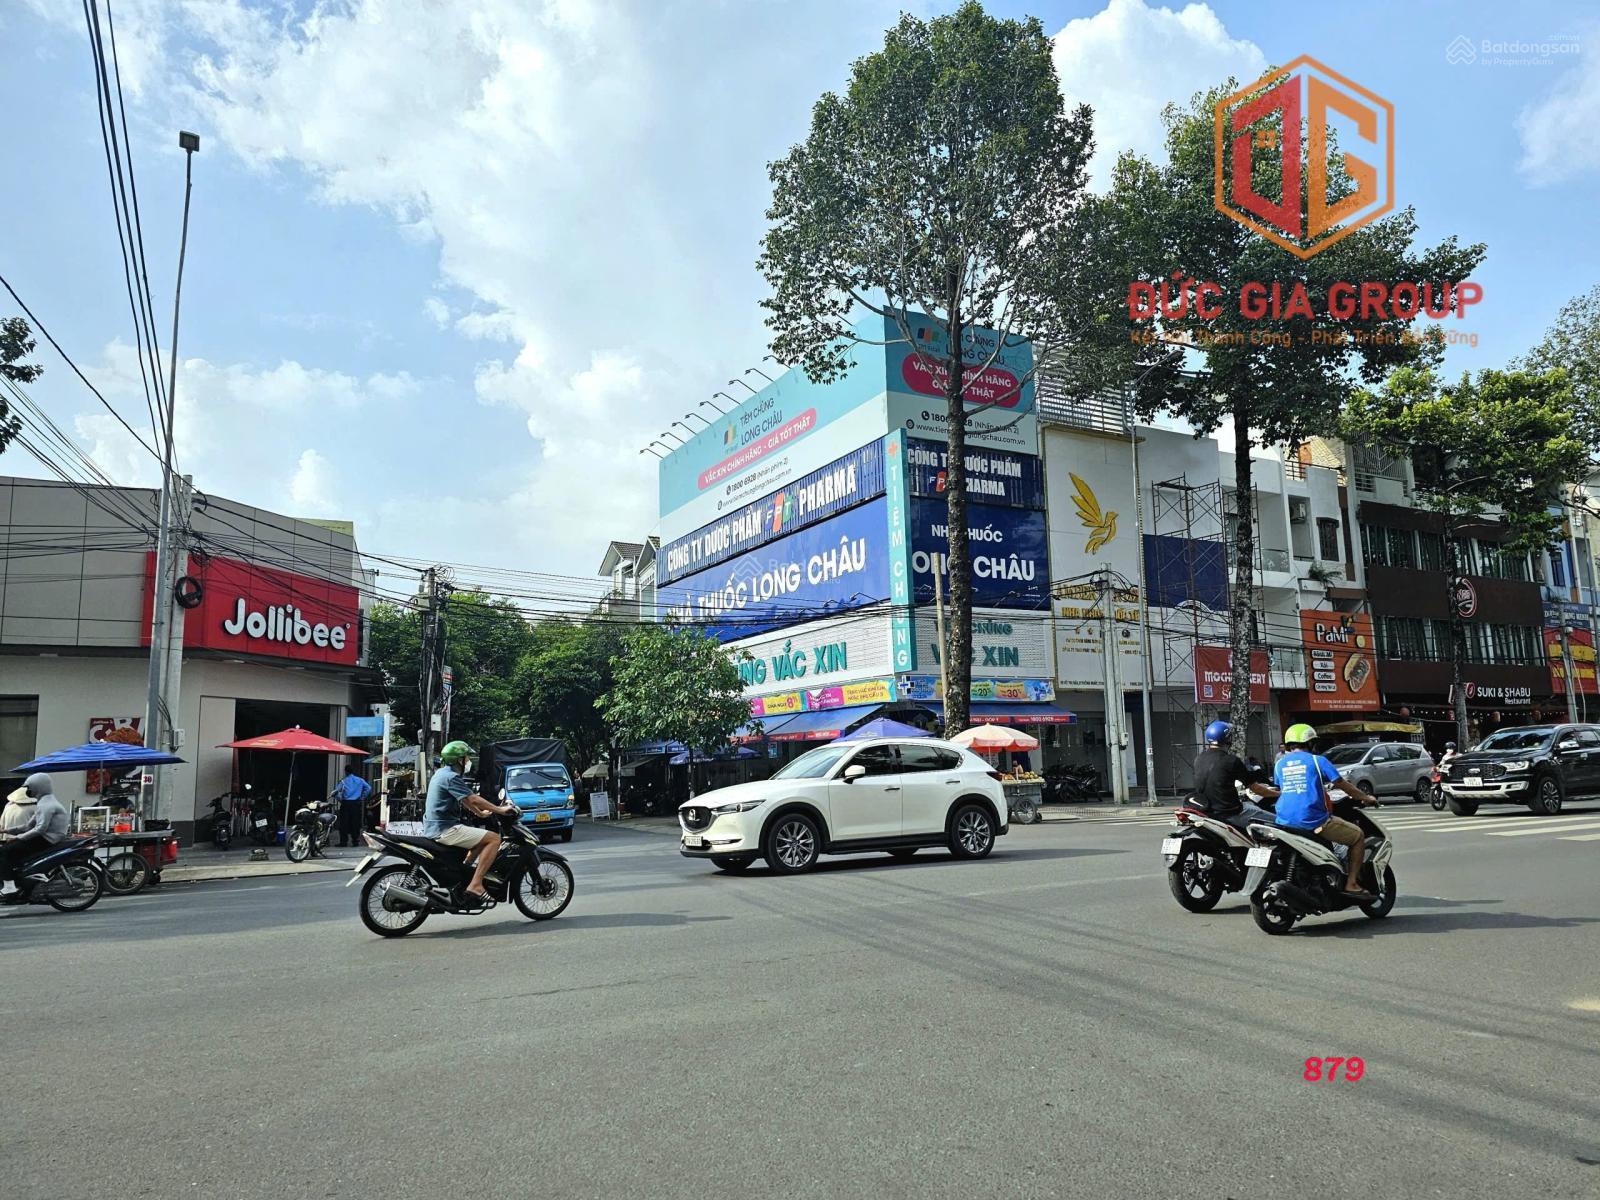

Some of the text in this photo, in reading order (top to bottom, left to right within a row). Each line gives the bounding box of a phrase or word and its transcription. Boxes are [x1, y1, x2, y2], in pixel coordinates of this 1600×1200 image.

[971, 387, 995, 399] THẬT
[985, 374, 1011, 387] HÃNG
[741, 410, 783, 446] LONG CHÂU
[907, 446, 938, 467] CÔNG
[964, 454, 989, 476] ƯỢC
[991, 457, 1021, 478] PHẨM
[966, 477, 1006, 496] HARMA
[668, 544, 689, 572] CÔNG
[691, 541, 702, 563] TY
[704, 528, 730, 558] DƯỢC
[764, 491, 793, 532] FPT
[799, 464, 857, 516] PHARMA
[931, 523, 1003, 543] NH HUỐC
[698, 573, 747, 621] THUỐC
[752, 563, 801, 603] LONG
[807, 535, 866, 586] CHÂU
[973, 553, 1035, 582] CHÂU
[224, 598, 346, 650] Jollibee
[1315, 623, 1349, 644] PaMi
[771, 639, 807, 681] VẮC
[813, 640, 847, 674] XIN
[982, 645, 1019, 667] XIN
[1477, 687, 1531, 698] SUKI & SHABU
